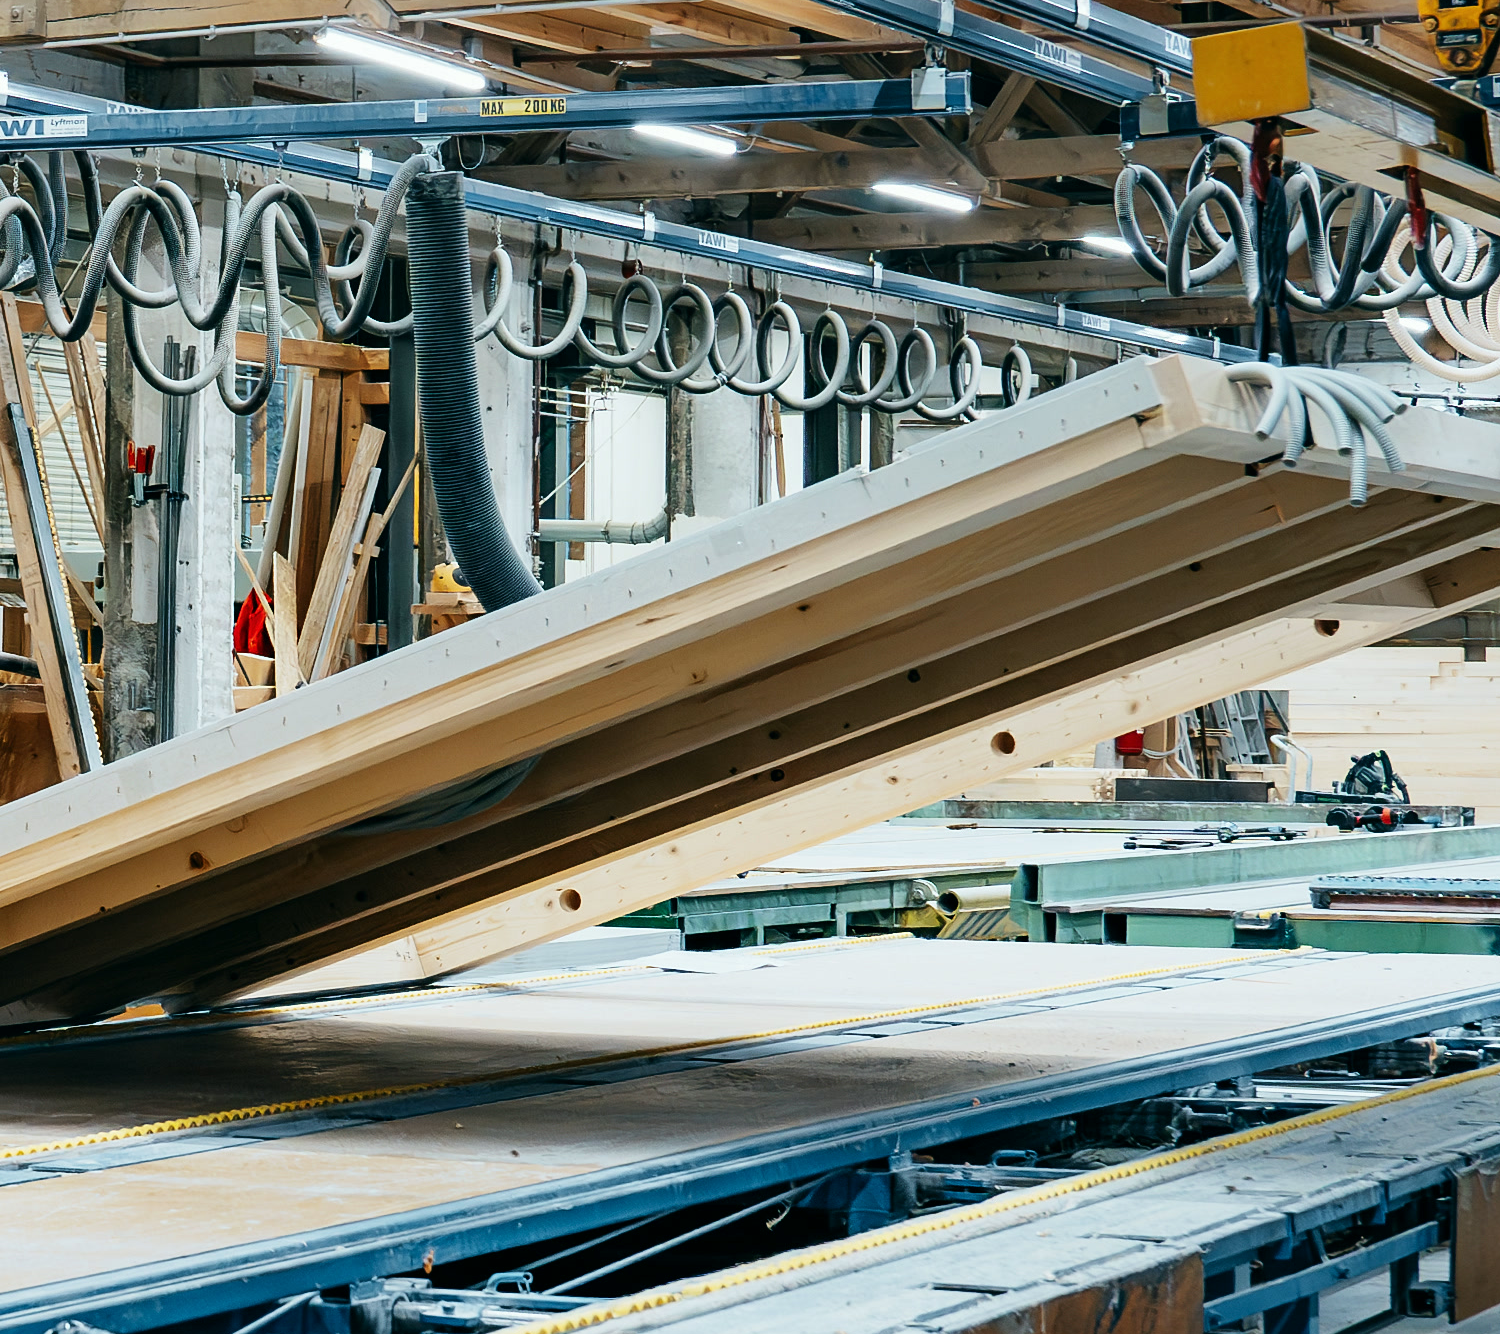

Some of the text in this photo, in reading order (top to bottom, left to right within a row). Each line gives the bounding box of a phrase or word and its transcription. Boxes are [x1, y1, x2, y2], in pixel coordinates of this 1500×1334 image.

[1036, 40, 1067, 63] TAWI
[482, 101, 504, 115] MAX
[524, 99, 547, 113] 200
[50, 118, 86, 128] Lyftman
[700, 232, 726, 248] TAWI
